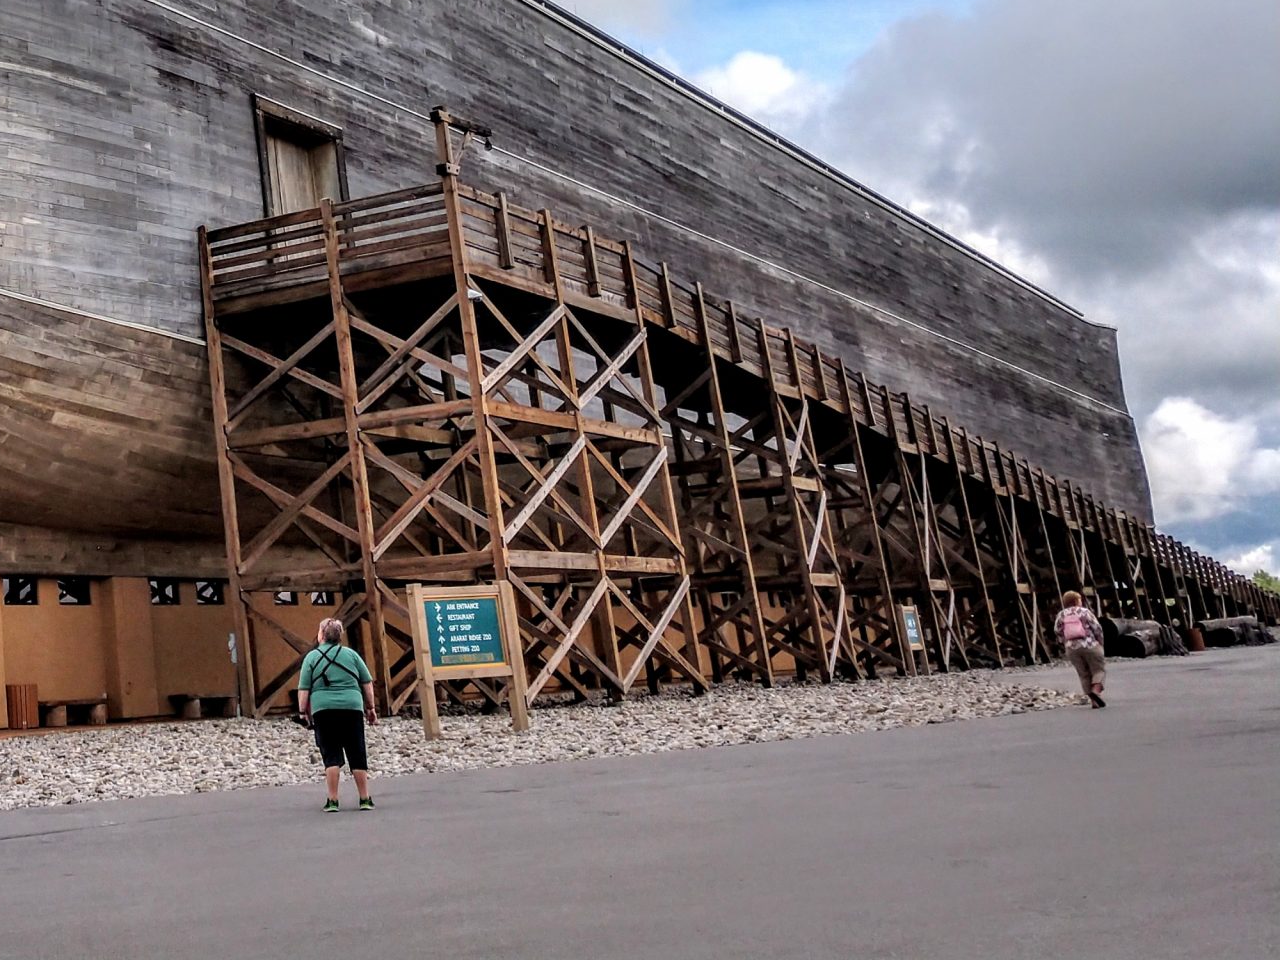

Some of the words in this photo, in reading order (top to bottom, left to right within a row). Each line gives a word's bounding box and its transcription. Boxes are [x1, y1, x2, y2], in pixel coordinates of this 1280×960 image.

[446, 603, 456, 611] ARK
[456, 602, 479, 610] ENTRANCE
[447, 613, 475, 621] RESTAURANT
[448, 624, 459, 632] GIFT
